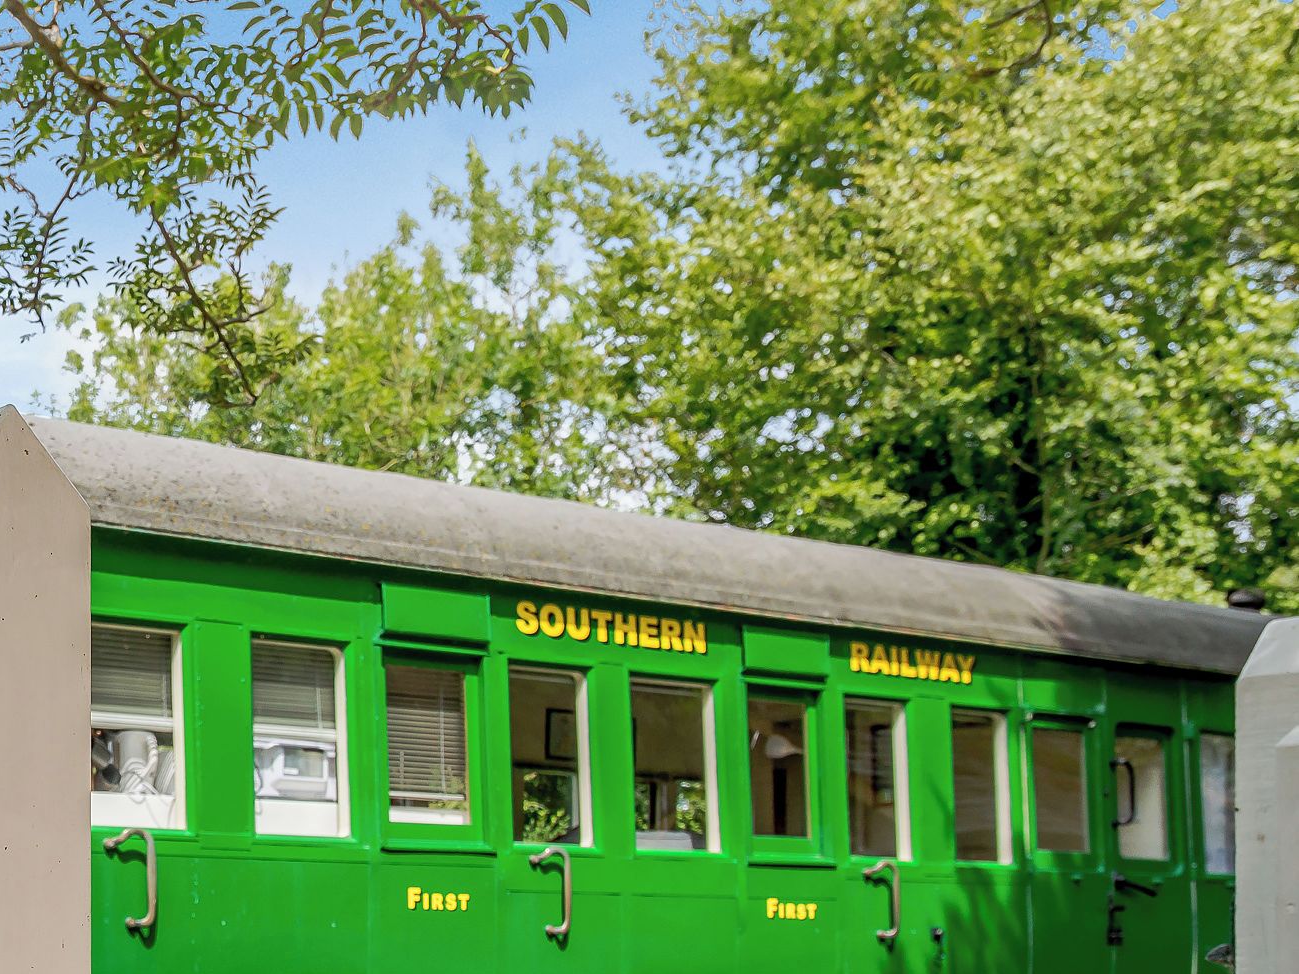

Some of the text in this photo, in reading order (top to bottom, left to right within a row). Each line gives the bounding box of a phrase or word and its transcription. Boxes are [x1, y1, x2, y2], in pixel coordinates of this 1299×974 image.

[515, 601, 975, 686] SOUTHERN RAILWAY
[406, 886, 471, 912] FIRST
